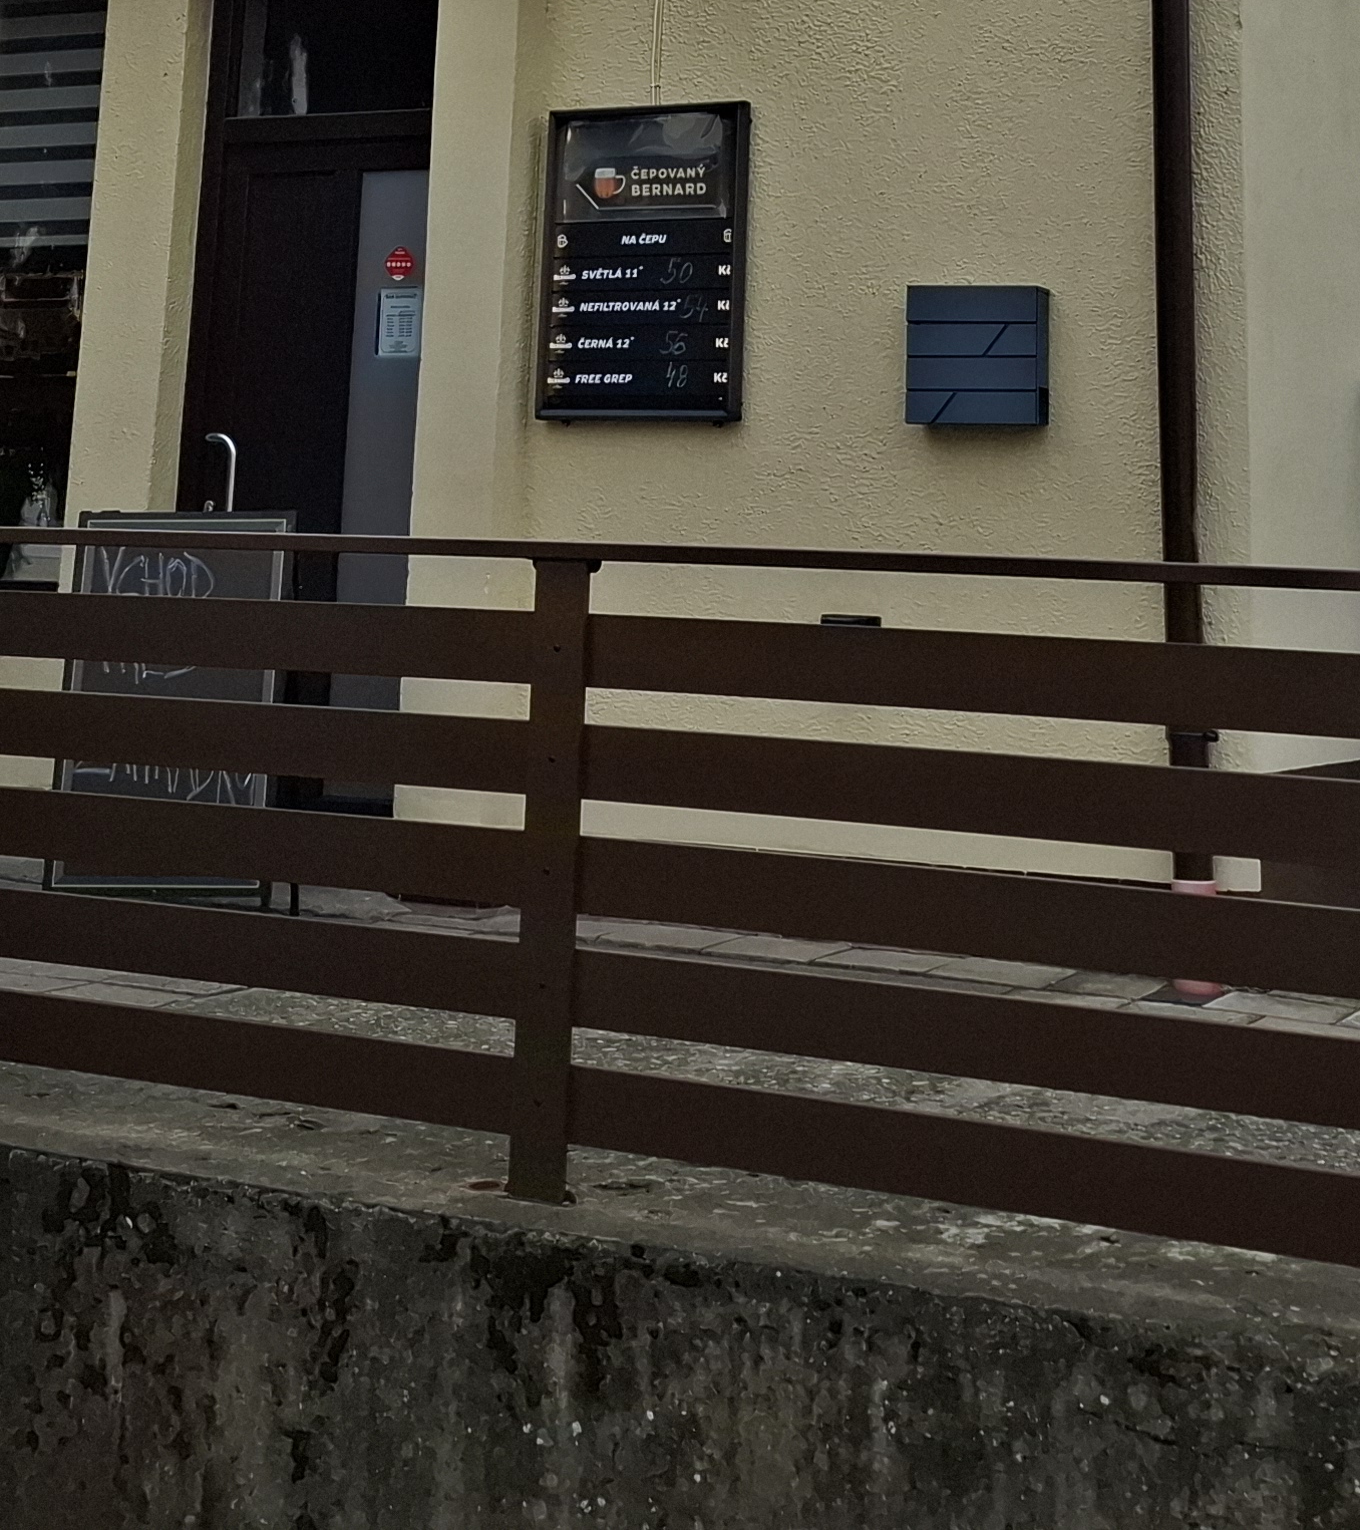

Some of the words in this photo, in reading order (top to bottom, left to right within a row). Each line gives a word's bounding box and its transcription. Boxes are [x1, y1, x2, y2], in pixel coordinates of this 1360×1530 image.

[630, 164, 706, 180] ČEPOVANÝ
[631, 182, 707, 197] BERNARD
[621, 235, 637, 245] NA
[638, 233, 667, 245] ČEPU
[581, 266, 622, 280] SVĚTLÁ
[579, 299, 660, 313] NEFILTROVANÁ
[577, 336, 614, 349] ČERNÁ
[715, 337, 729, 348] Kč
[575, 373, 602, 384] FREE
[603, 373, 633, 384] GREP
[713, 372, 728, 383] Kč
